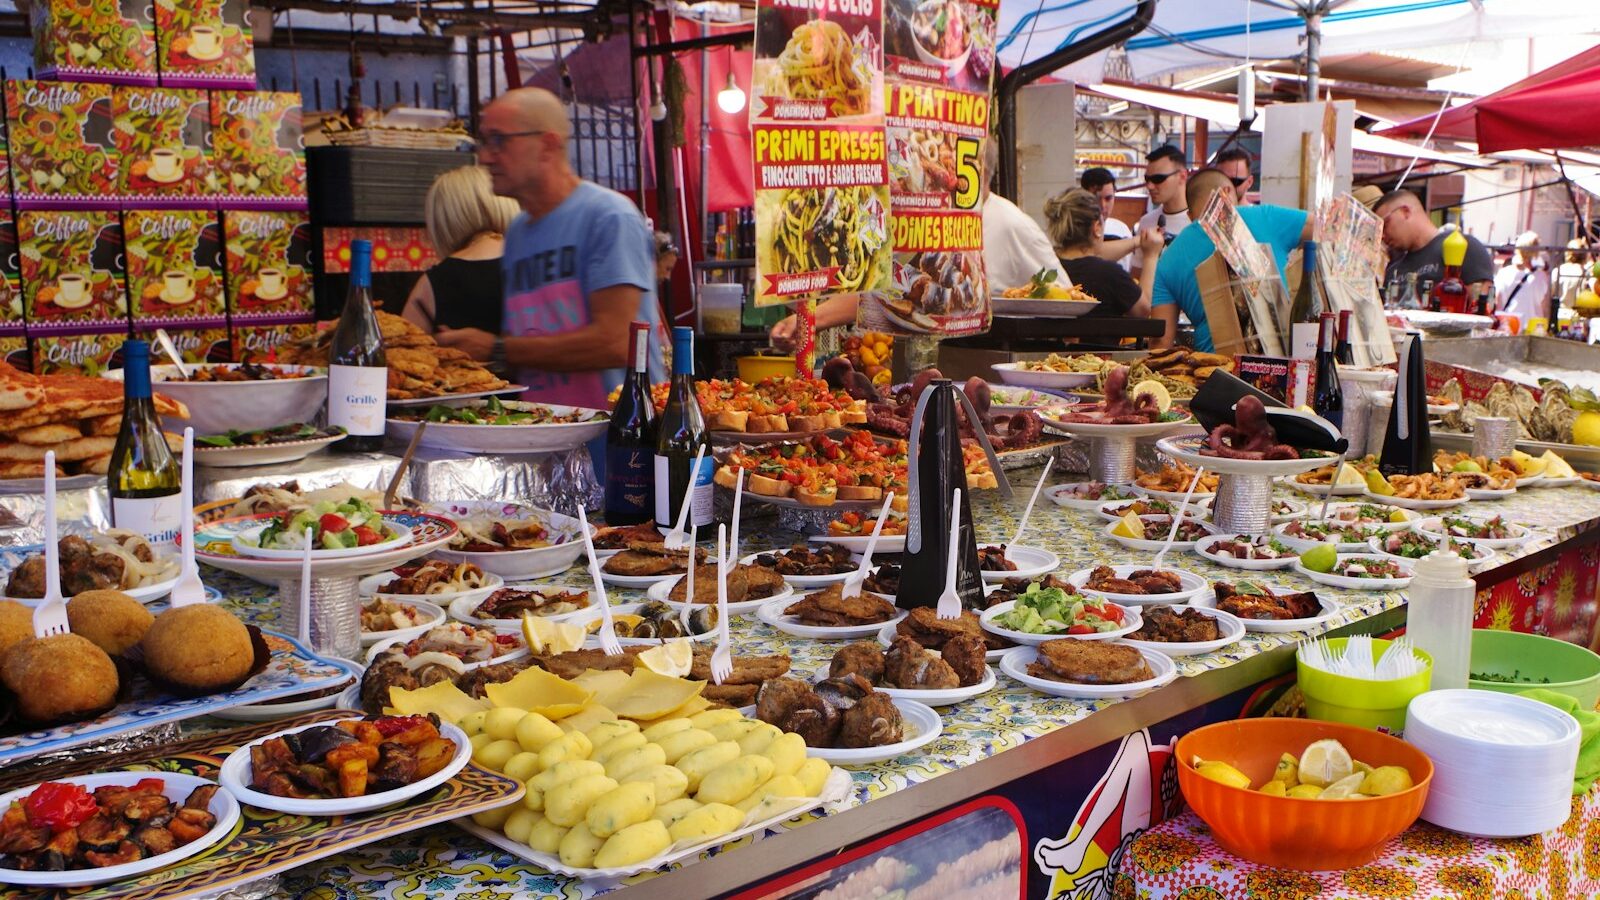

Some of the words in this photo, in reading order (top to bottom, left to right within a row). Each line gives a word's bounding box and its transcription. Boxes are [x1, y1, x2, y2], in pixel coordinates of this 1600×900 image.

[25, 87, 81, 111] Coffea
[128, 91, 181, 116] Coffea
[226, 95, 276, 118] Coffea
[761, 165, 826, 187] FINOCCHIETTO
[826, 165, 832, 185] E
[832, 165, 855, 185] SARDE
[855, 164, 883, 184] FRESCHE
[955, 136, 980, 209] 5
[34, 215, 90, 241] Coffea
[140, 216, 193, 240] Coffea
[239, 216, 285, 239] Coffea
[778, 278, 810, 294] DOMENICO
[810, 275, 828, 289] FOOD
[48, 339, 101, 364] Coffea
[150, 334, 201, 356] Cffea
[346, 395, 377, 404] Grillo
